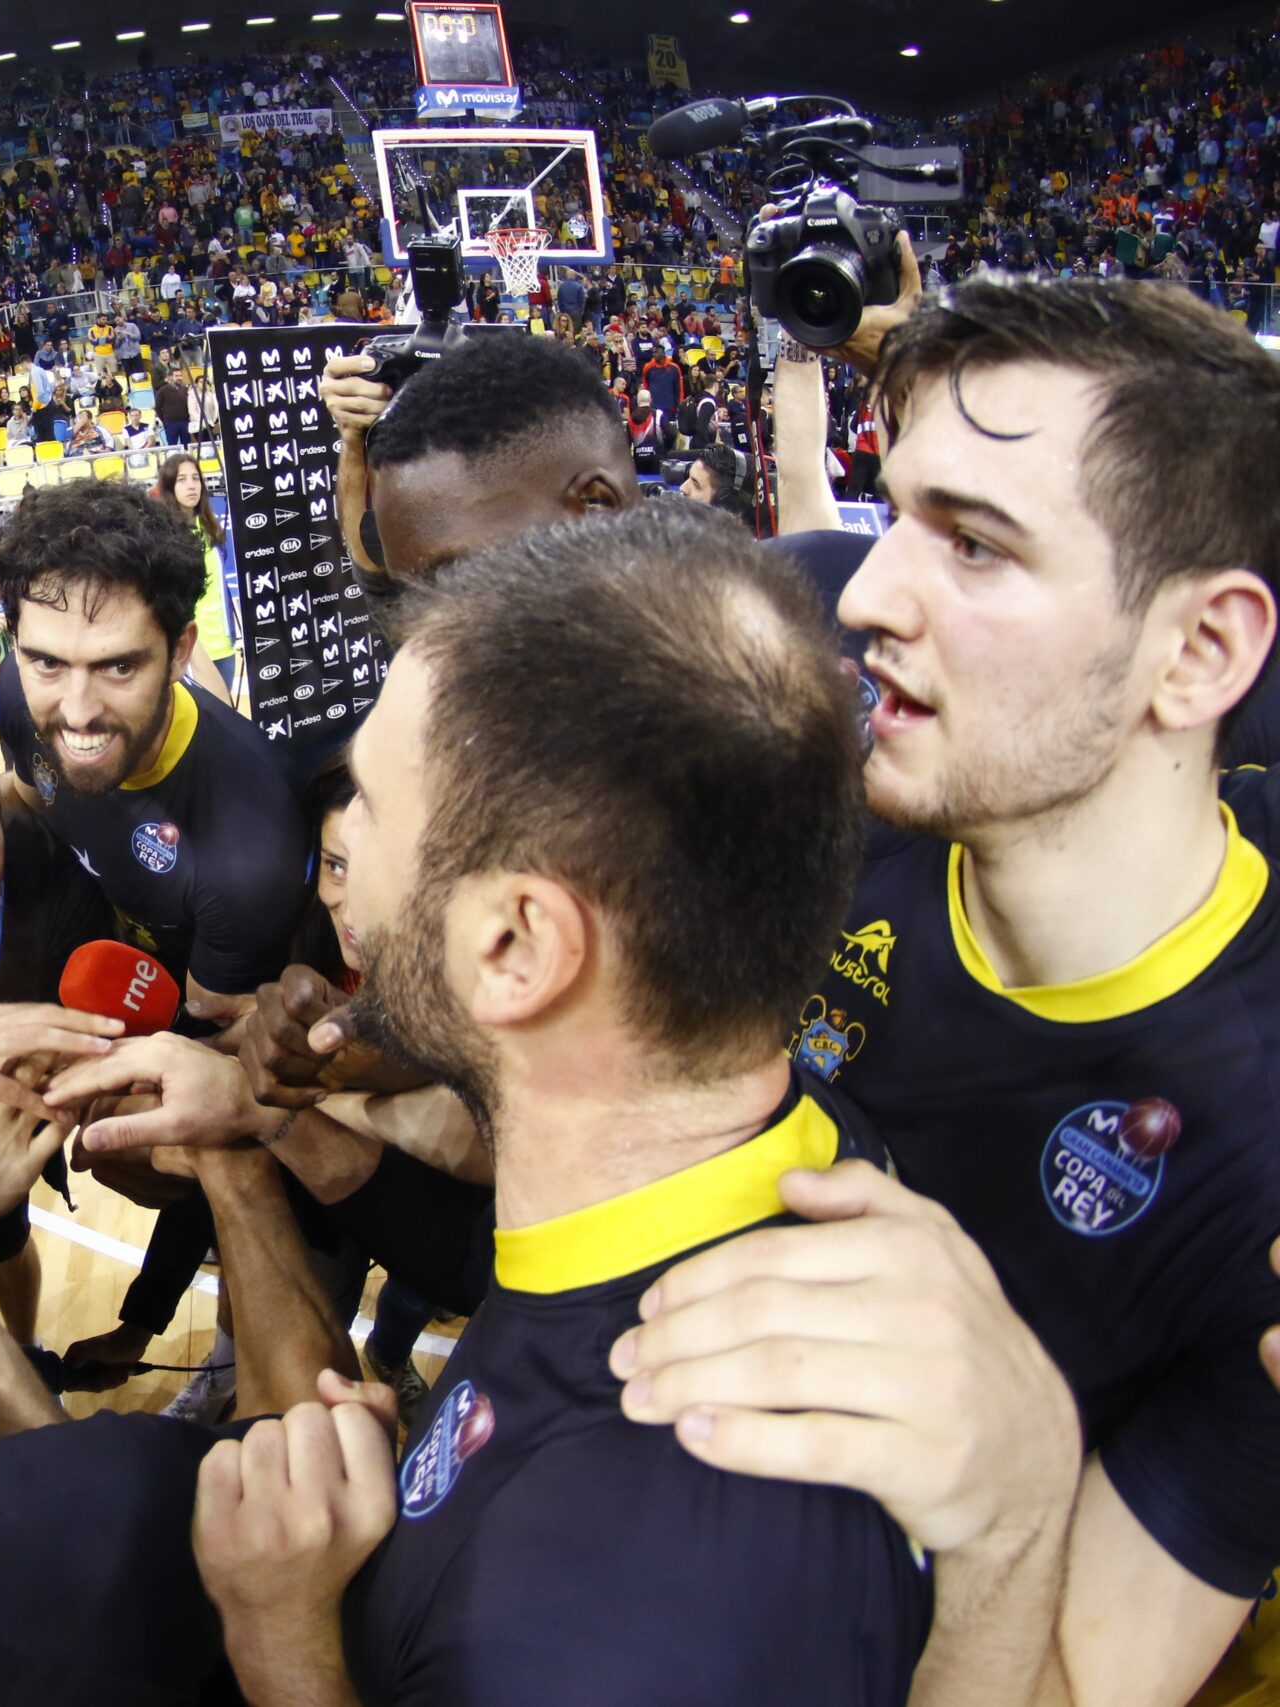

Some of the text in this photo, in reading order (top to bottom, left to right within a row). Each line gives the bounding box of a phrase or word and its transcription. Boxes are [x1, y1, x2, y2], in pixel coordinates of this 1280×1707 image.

[655, 49, 677, 69] 20
[462, 93, 518, 104] movistar
[241, 116, 256, 129] LOS
[276, 113, 290, 126] DEL
[291, 112, 313, 125] TIGRE
[807, 217, 838, 226] Canon
[414, 350, 441, 359] Canon
[300, 445, 327, 455] endesa
[244, 547, 275, 559] endesa
[281, 570, 307, 582] endesa
[312, 593, 339, 605] endesa
[344, 615, 369, 626] endesa
[259, 695, 288, 709] endesa
[293, 714, 322, 728] endesa
[136, 841, 158, 858] COPA
[139, 851, 164, 871] REY
[123, 959, 158, 1012] rne
[1054, 1149, 1107, 1197] COPA
[1052, 1175, 1114, 1229] REY
[425, 1416, 443, 1474] COPA
[406, 1443, 430, 1505] REY
